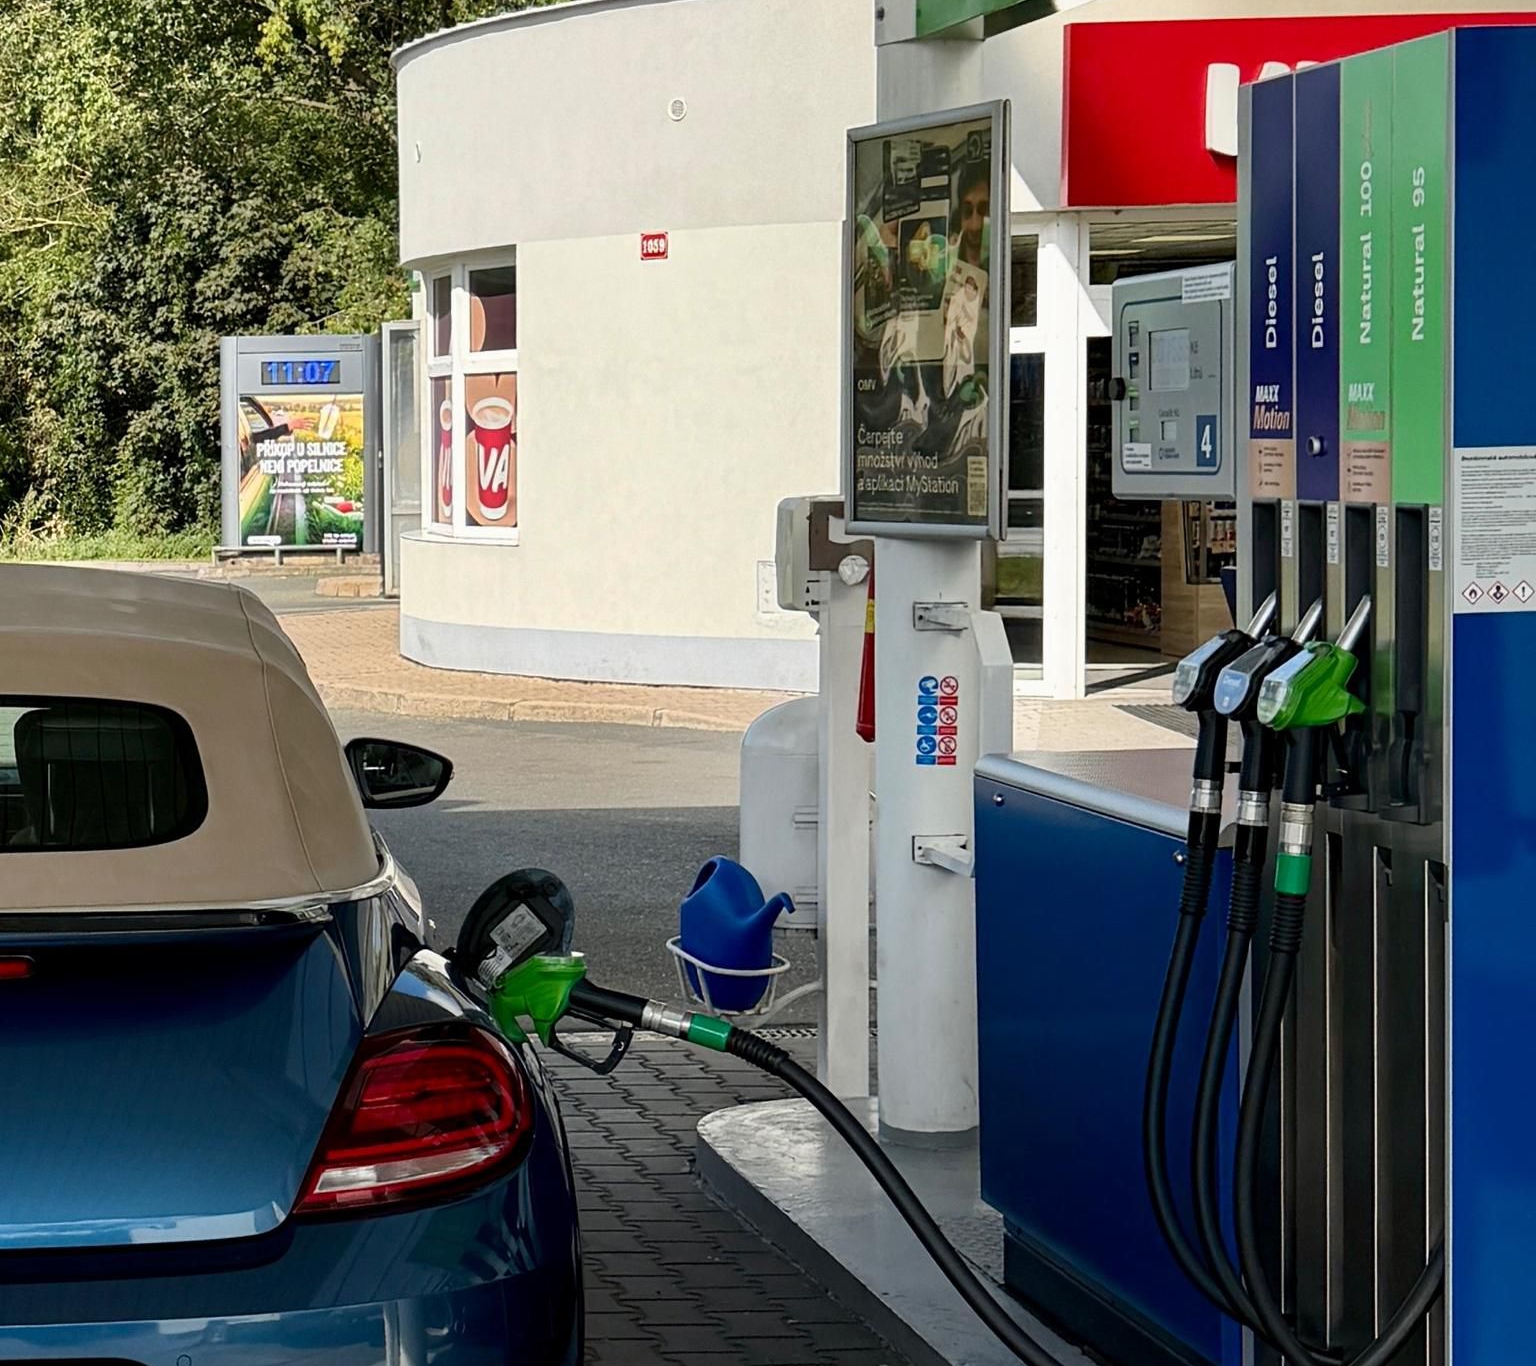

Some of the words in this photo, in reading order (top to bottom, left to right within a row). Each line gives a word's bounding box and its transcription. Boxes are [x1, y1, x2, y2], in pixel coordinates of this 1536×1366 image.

[1360, 161, 1373, 217] 100
[1413, 166, 1425, 207] 95
[642, 238, 665, 254] 1059
[1360, 232, 1372, 344] Natural
[1412, 223, 1425, 341] Natural
[1265, 255, 1277, 349] Diesel
[1312, 251, 1324, 349] Diesel
[267, 361, 335, 383] 11:07
[857, 378, 877, 391] OMV
[1255, 385, 1280, 402] MAXX
[1348, 382, 1375, 402] MAXX
[1253, 405, 1290, 430] Motion
[857, 424, 903, 448] Čerpejte
[1201, 424, 1212, 459] 4
[297, 443, 305, 456] U
[307, 442, 347, 456] SILNICE
[287, 458, 344, 474] POPELNICE
[857, 451, 904, 469] množství
[907, 452, 938, 473] výhod
[906, 474, 959, 497] MyStation
